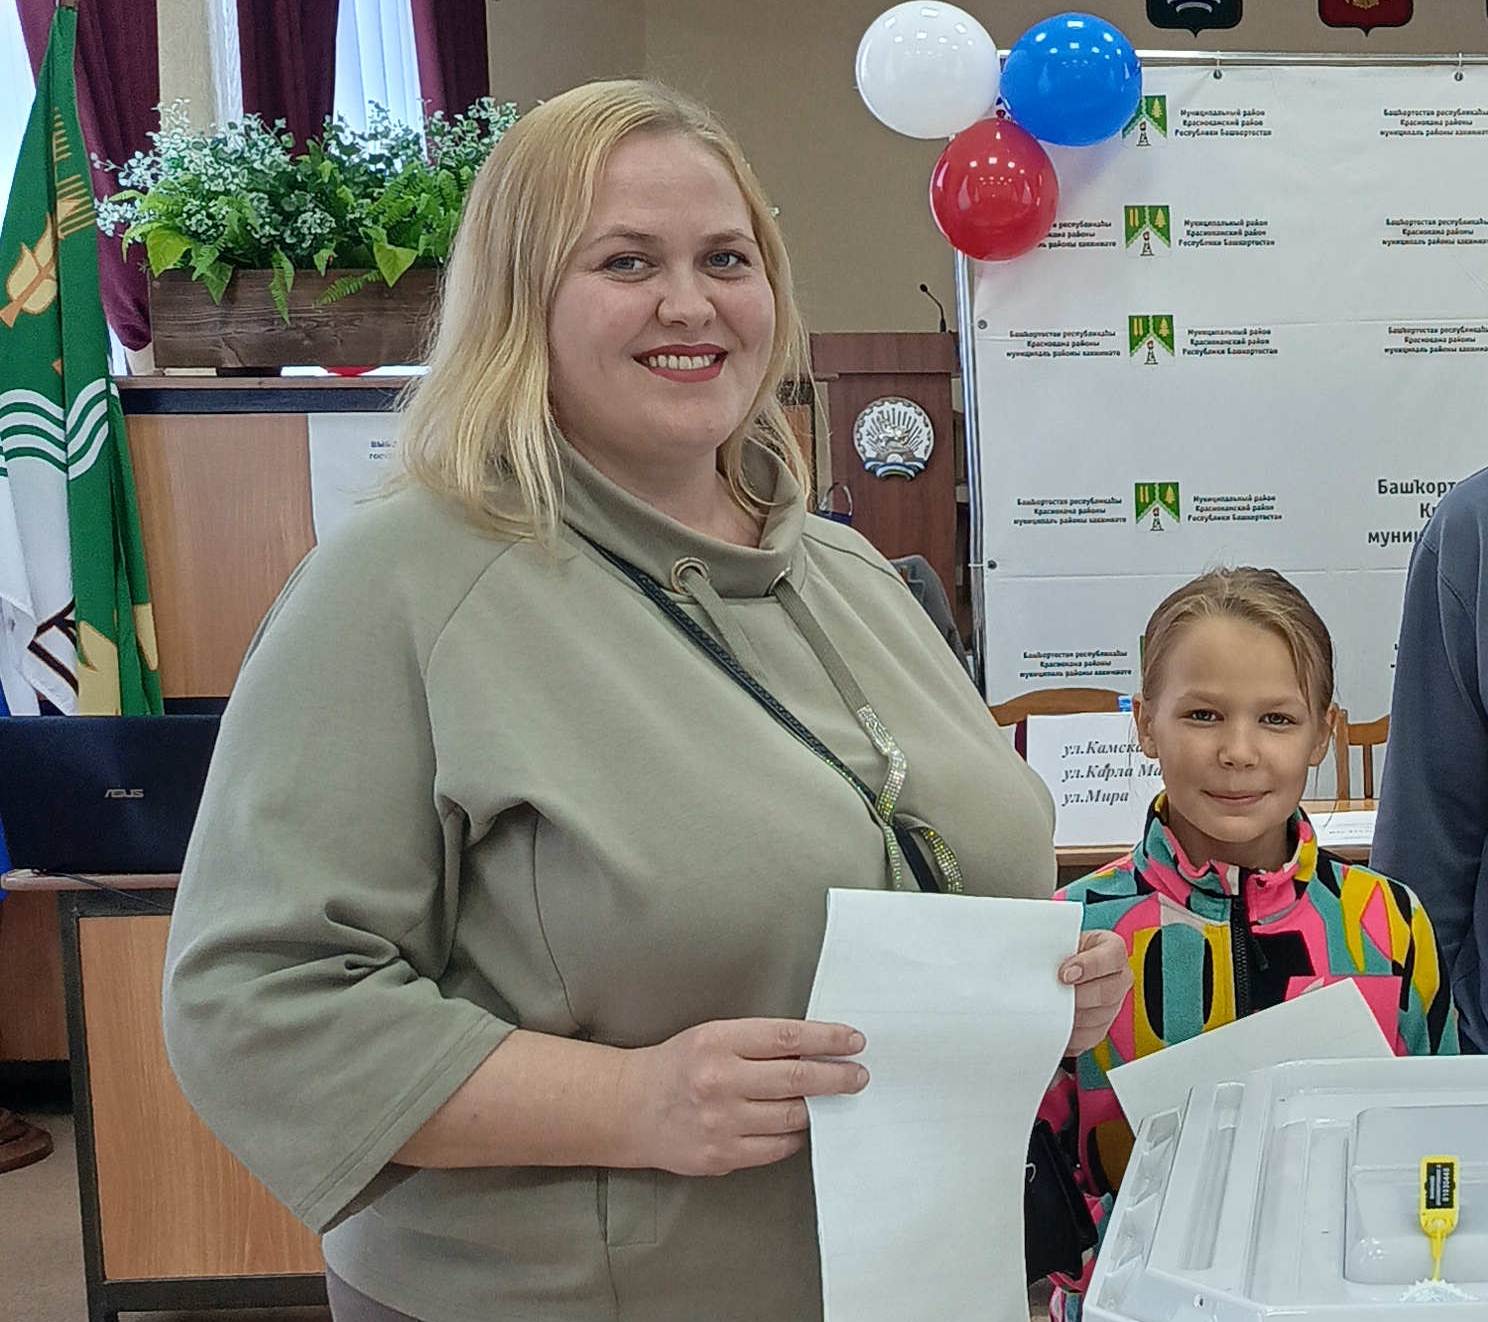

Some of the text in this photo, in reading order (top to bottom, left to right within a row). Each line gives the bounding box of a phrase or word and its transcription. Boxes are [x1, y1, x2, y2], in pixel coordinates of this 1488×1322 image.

[1378, 479, 1456, 497] Башҡорт
[1062, 740, 1142, 758] ул.Камска
[1062, 763, 1133, 782] ул.Карла
[104, 789, 144, 798] ASUS
[1062, 788, 1129, 806] ул.Мира
